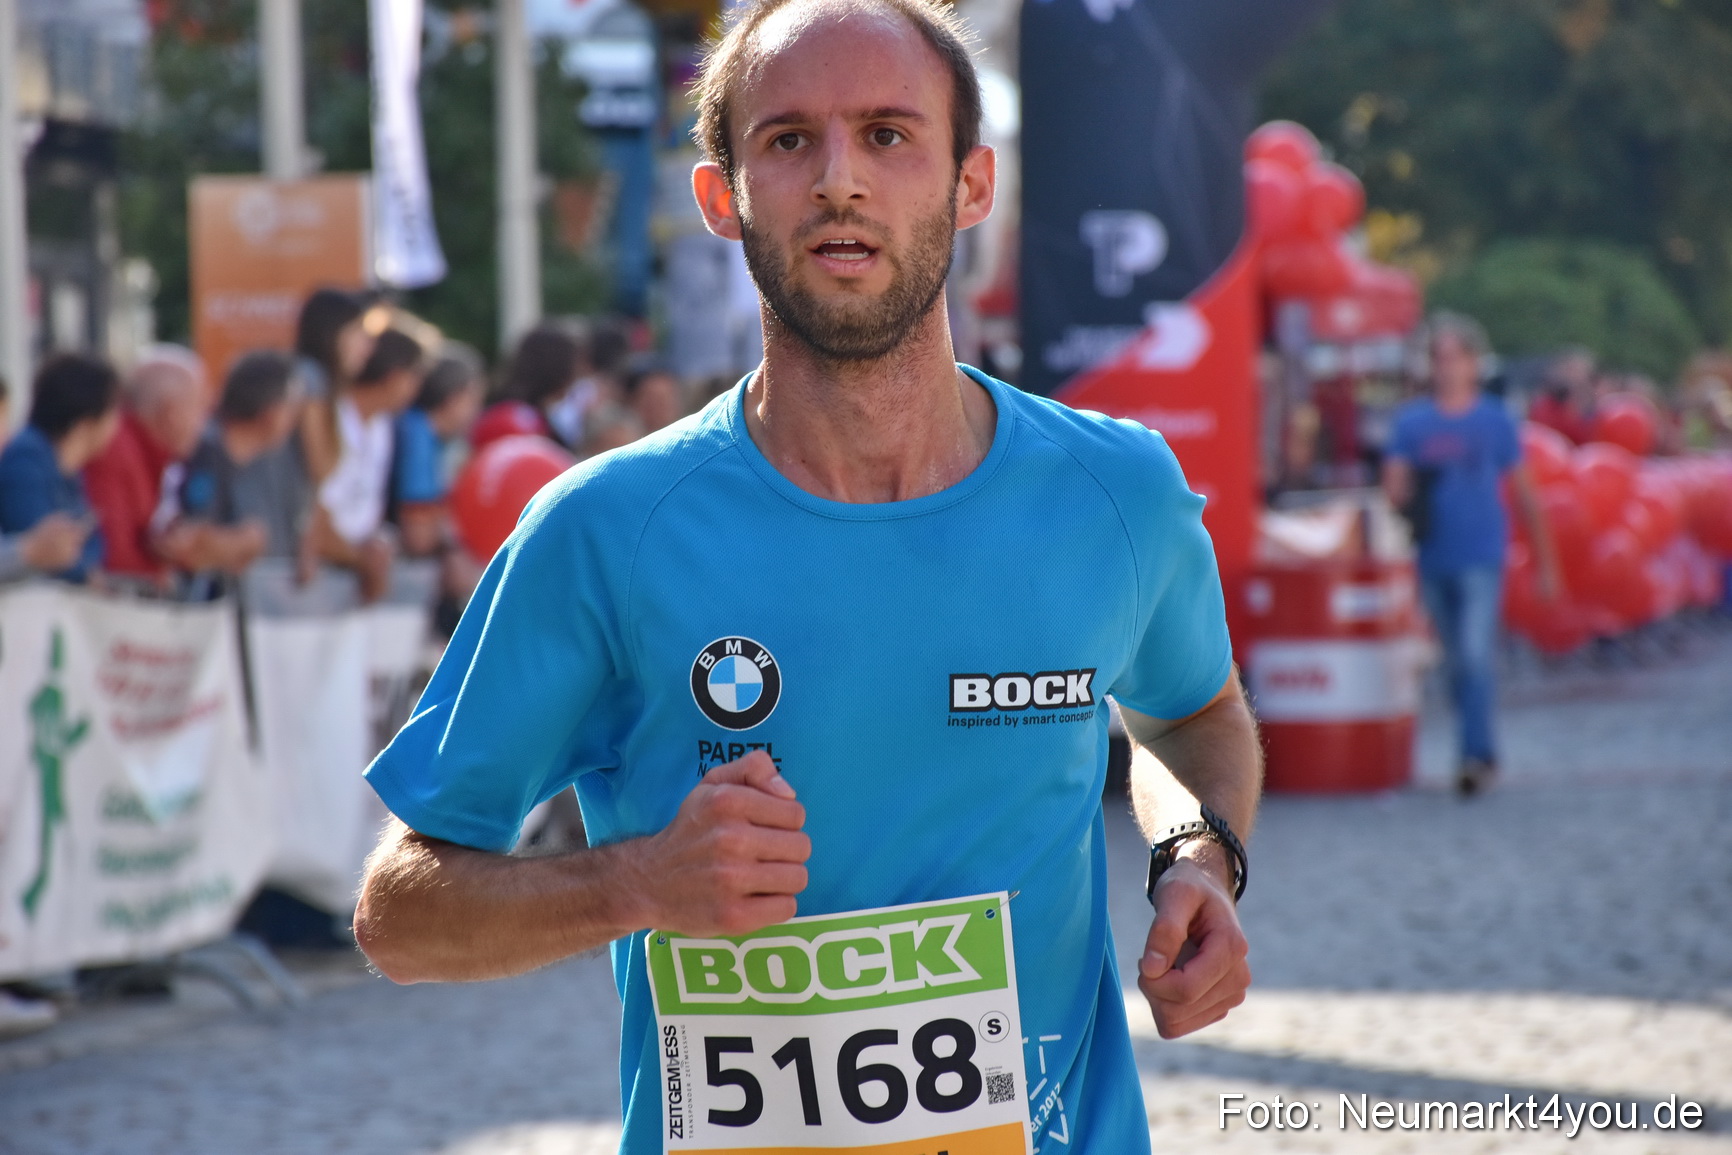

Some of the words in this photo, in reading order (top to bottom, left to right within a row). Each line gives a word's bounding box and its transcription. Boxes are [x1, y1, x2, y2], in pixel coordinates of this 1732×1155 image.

[698, 640, 773, 671] BMW
[950, 669, 1095, 711] BOCK
[947, 715, 1000, 729] inspired
[1004, 715, 1018, 728] by
[1023, 713, 1056, 725] smart
[1059, 710, 1094, 724] concepts
[673, 915, 978, 1001] BOCK
[681, 1025, 691, 1077] ZEITMESSUNG
[704, 1018, 983, 1127] 5168
[686, 1082, 694, 1139] TRANSPONDER
